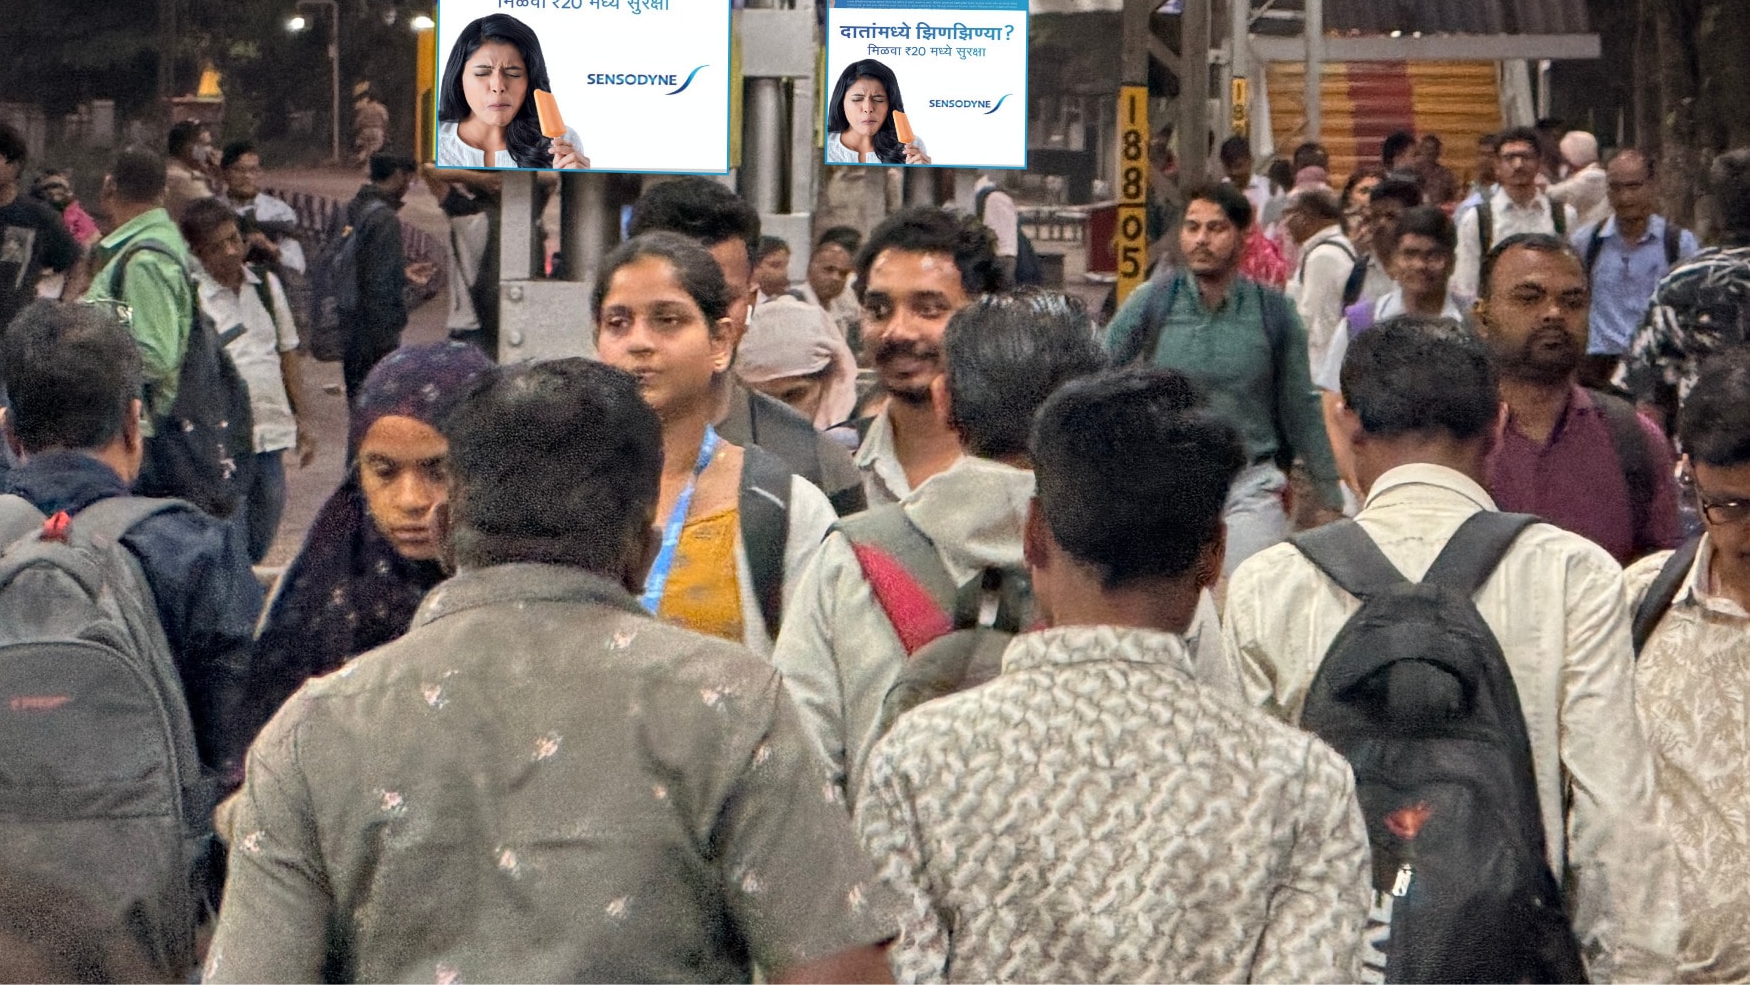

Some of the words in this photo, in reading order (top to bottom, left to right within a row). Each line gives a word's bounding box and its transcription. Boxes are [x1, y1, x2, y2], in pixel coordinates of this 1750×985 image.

[840, 22, 911, 40] दातांमध्ये
[867, 43, 901, 56] मिळवा
[905, 47, 926, 56] ₹20
[930, 44, 952, 57] मध्ये
[956, 47, 986, 60] सुरक्षा
[587, 73, 678, 86] SENSODYNE
[929, 99, 991, 109] SENSODYNE
